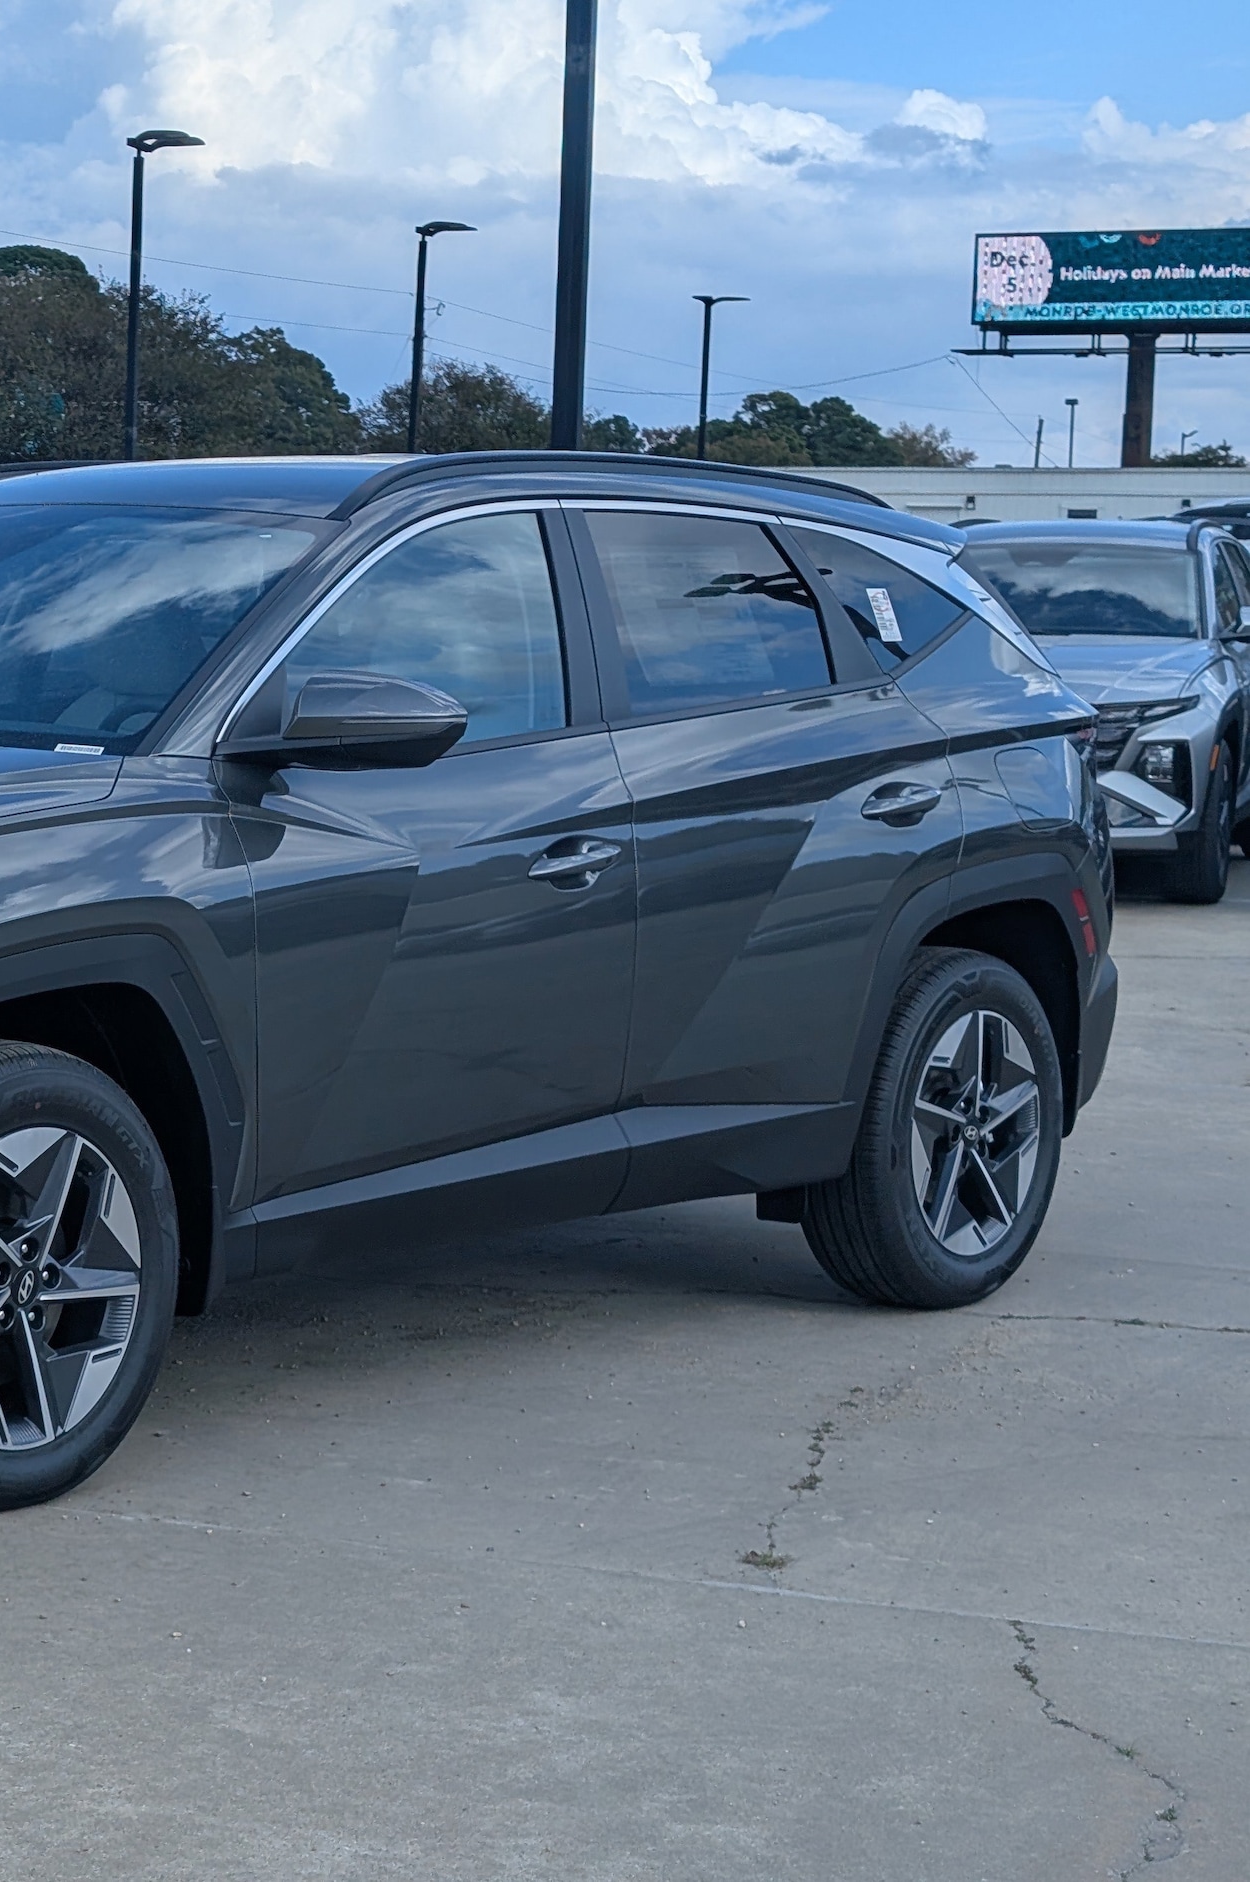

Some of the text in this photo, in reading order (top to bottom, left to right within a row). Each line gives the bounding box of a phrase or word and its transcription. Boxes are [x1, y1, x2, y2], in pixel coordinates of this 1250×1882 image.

[1060, 265, 1128, 284] Holidays
[1131, 267, 1153, 280] on
[1154, 262, 1196, 280] Main
[1006, 276, 1017, 293] 5
[115, 1125, 152, 1168] GTX
